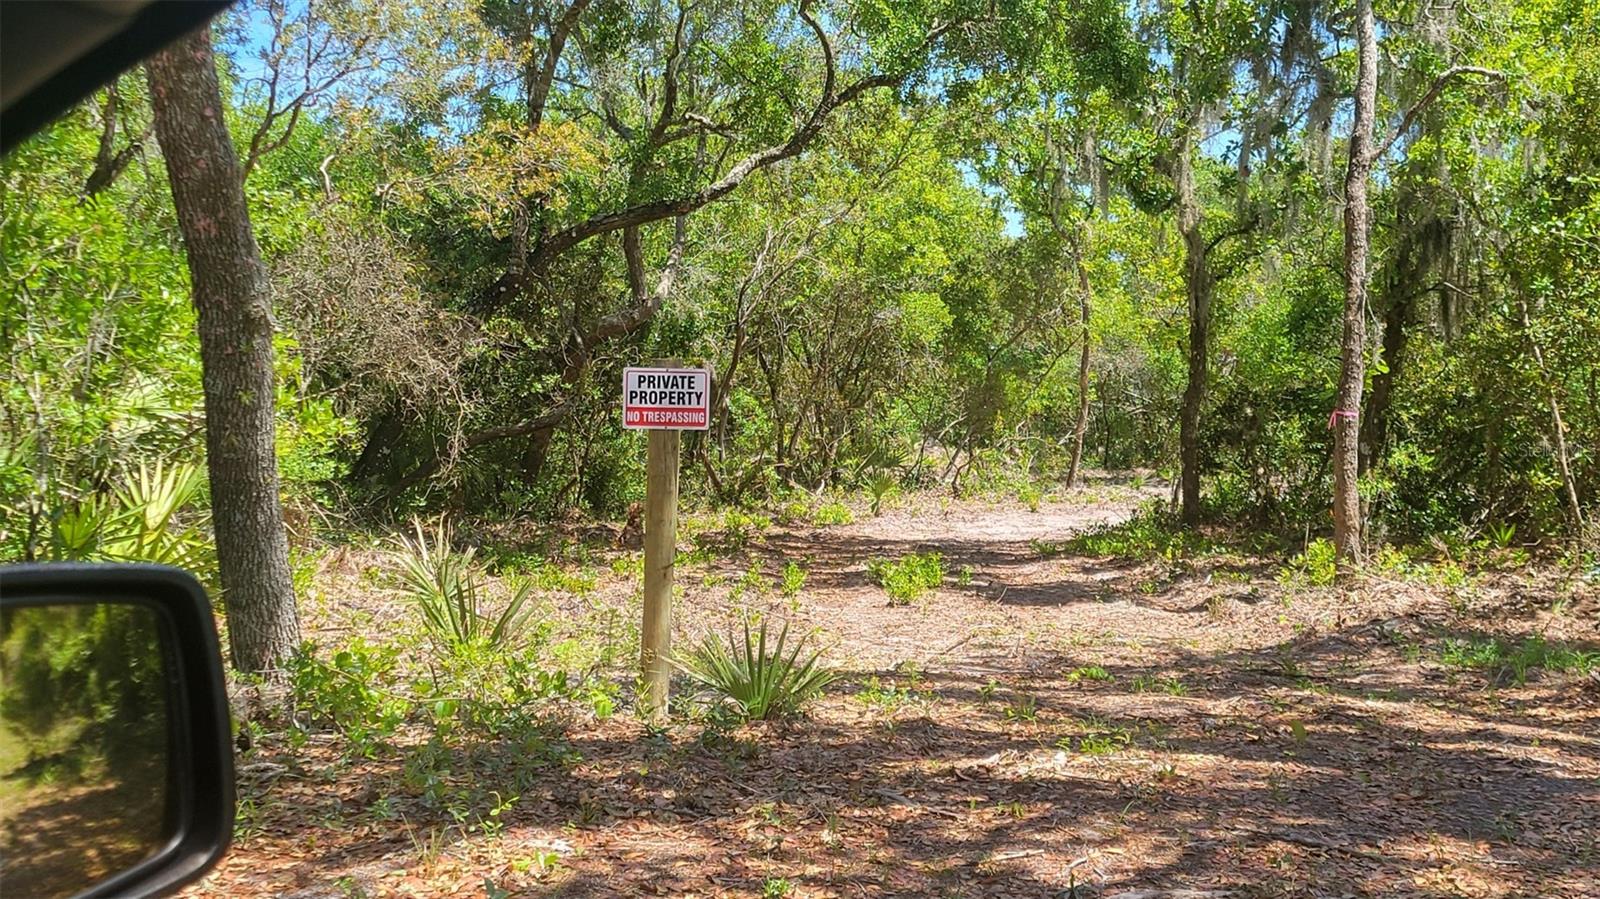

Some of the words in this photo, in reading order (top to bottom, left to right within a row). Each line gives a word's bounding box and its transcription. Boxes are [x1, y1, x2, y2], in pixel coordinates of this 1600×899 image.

[638, 375, 695, 389] PRIVATE
[629, 391, 703, 405] PROPERTY
[627, 411, 640, 422] NO
[642, 411, 705, 423] TRESPASSING
